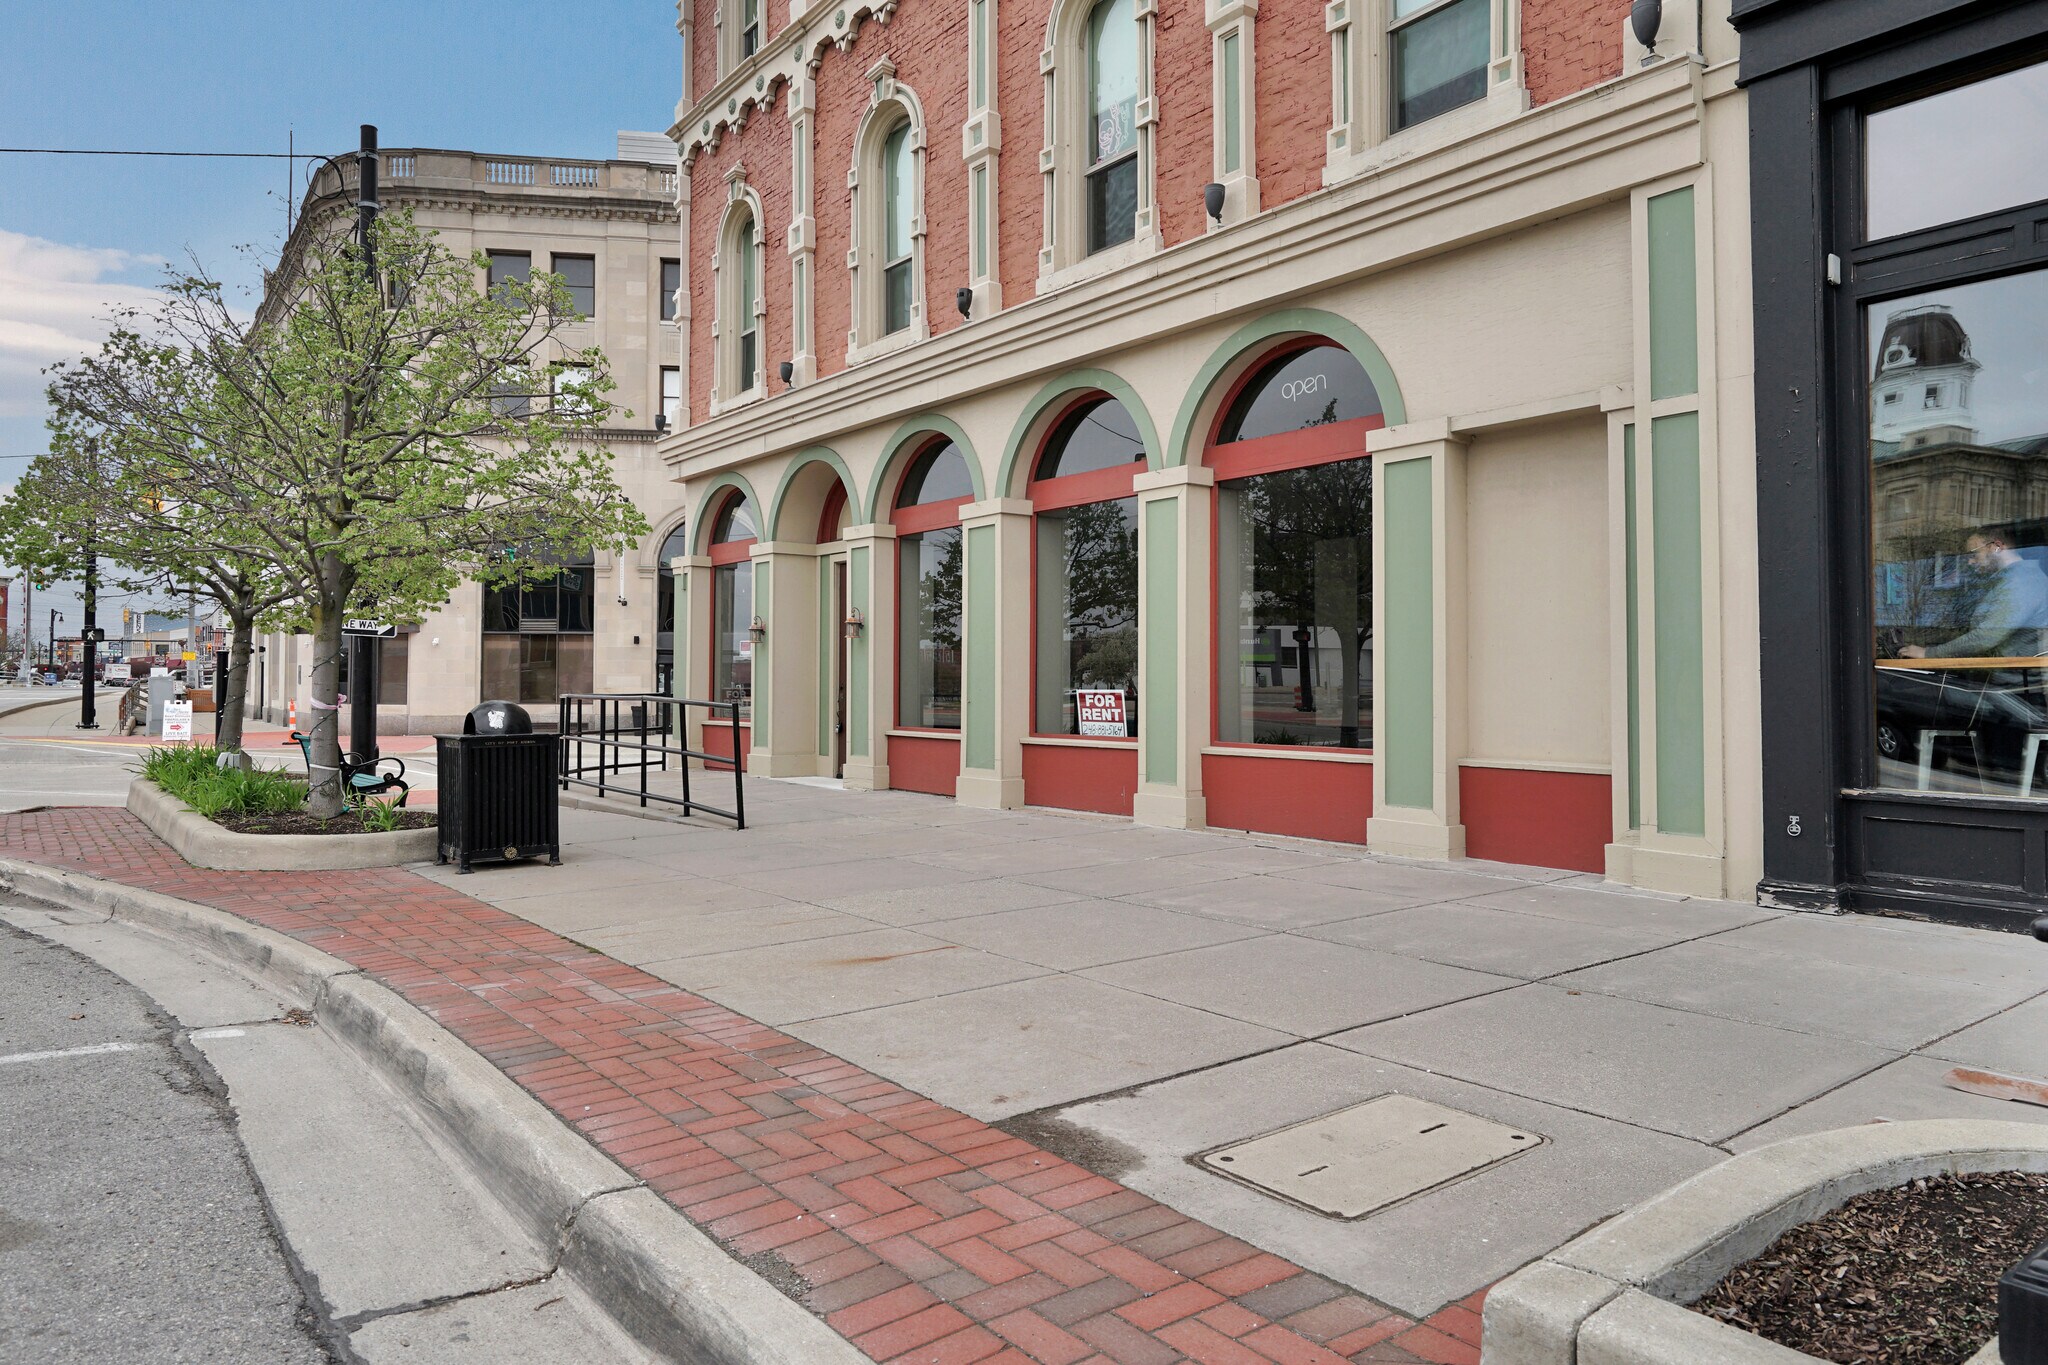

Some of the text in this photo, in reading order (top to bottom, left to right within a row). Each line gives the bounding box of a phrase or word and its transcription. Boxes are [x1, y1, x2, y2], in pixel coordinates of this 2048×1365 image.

[1281, 374, 1327, 402] open
[342, 620, 379, 630] NE WAY
[1085, 694, 1116, 707] FOR
[1081, 707, 1122, 722] RENT
